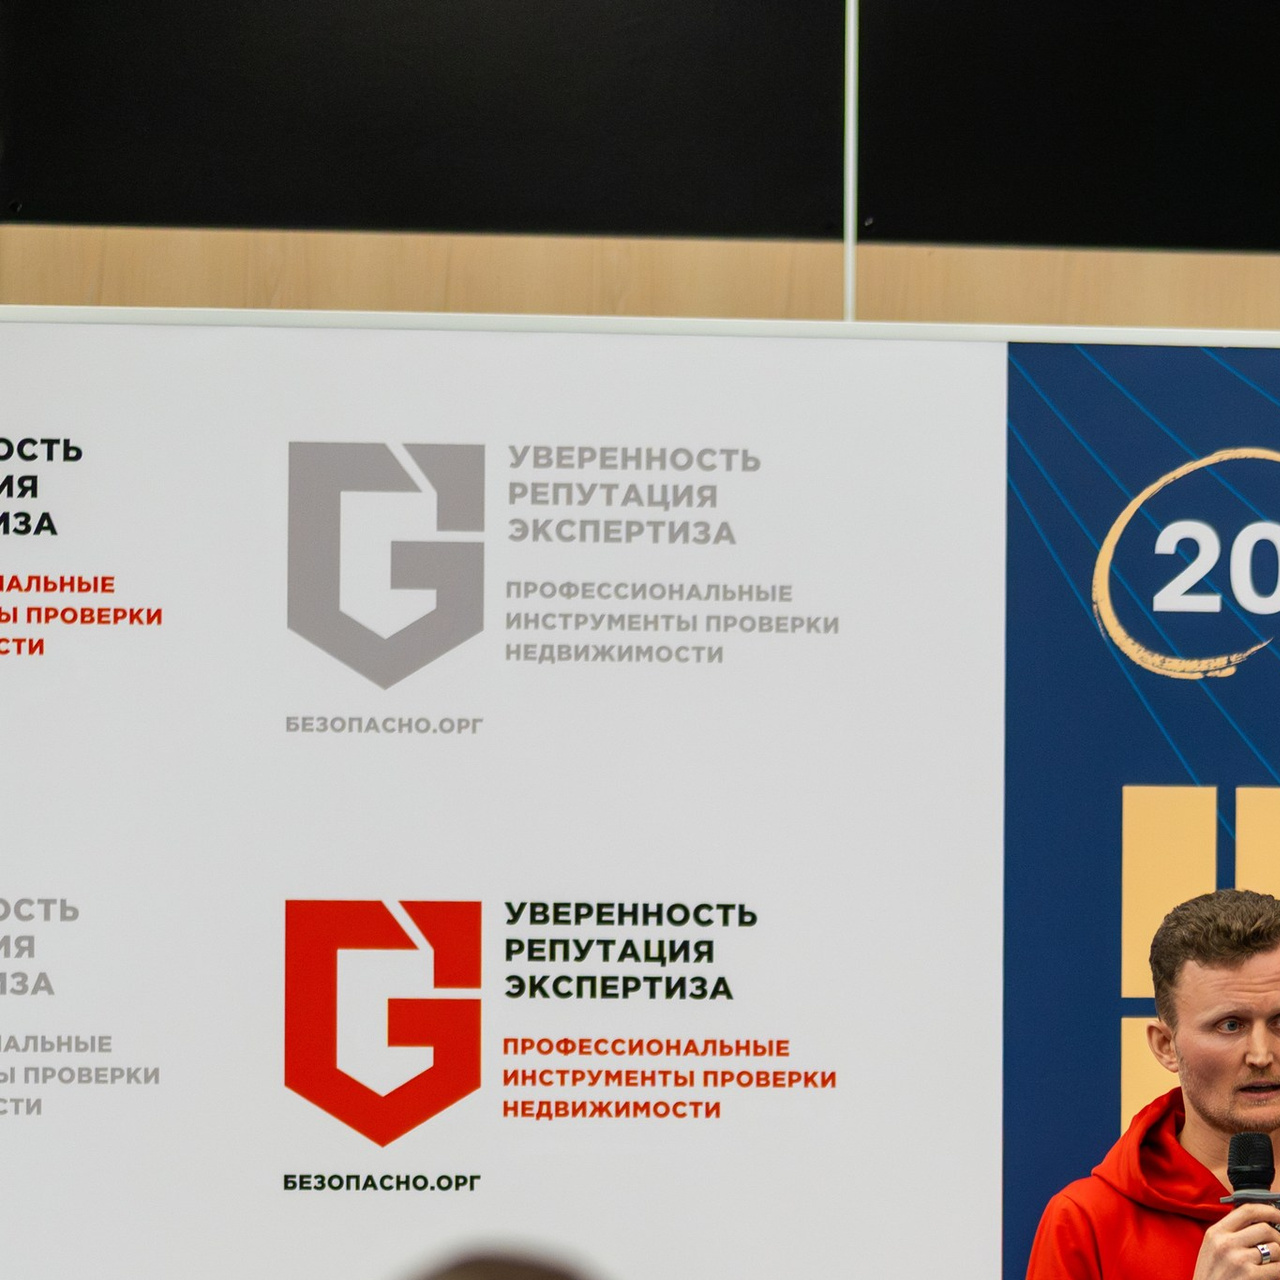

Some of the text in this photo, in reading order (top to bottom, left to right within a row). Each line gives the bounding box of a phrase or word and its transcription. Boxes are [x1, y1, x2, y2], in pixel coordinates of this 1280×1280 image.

[508, 445, 762, 472] УВЕРЕННОСТЬ
[508, 482, 718, 511] РЕПУТАЦИЯ
[508, 518, 737, 545] ЭКСПЕРТИЗА
[0, 575, 115, 593] АЛЬНЫЕ
[505, 581, 793, 603] ПРОФЕССИОНАЛЬНЫЕ
[26, 607, 163, 626] ПРОВЕРКИ
[505, 612, 839, 634] ИНСТРУМЕНТЫ ПРОВЕРКИ
[505, 643, 724, 665] НЕДВИЖИМОСТИ
[285, 716, 484, 735] БЕЗОПАСНО.ОРГ
[504, 901, 759, 928] УВЕРЕННОСТЬ
[504, 938, 715, 967] РЕПУТАЦИЯ
[504, 974, 734, 1001] ЭКСПЕРТИЗА
[0, 1035, 112, 1053] АЛЬНЫЕ
[502, 1037, 790, 1058] ПРОФЕССИОНАЛЬНЫЕ
[24, 1067, 160, 1085] ПРОВЕРКИ
[502, 1069, 837, 1090] ИНСТРУМЕНТЫ ПРОВЕРКИ
[502, 1099, 722, 1122] НЕДВИЖИМОСТИ
[282, 1173, 482, 1192] БЕЗОПАСНО.ОРГ
